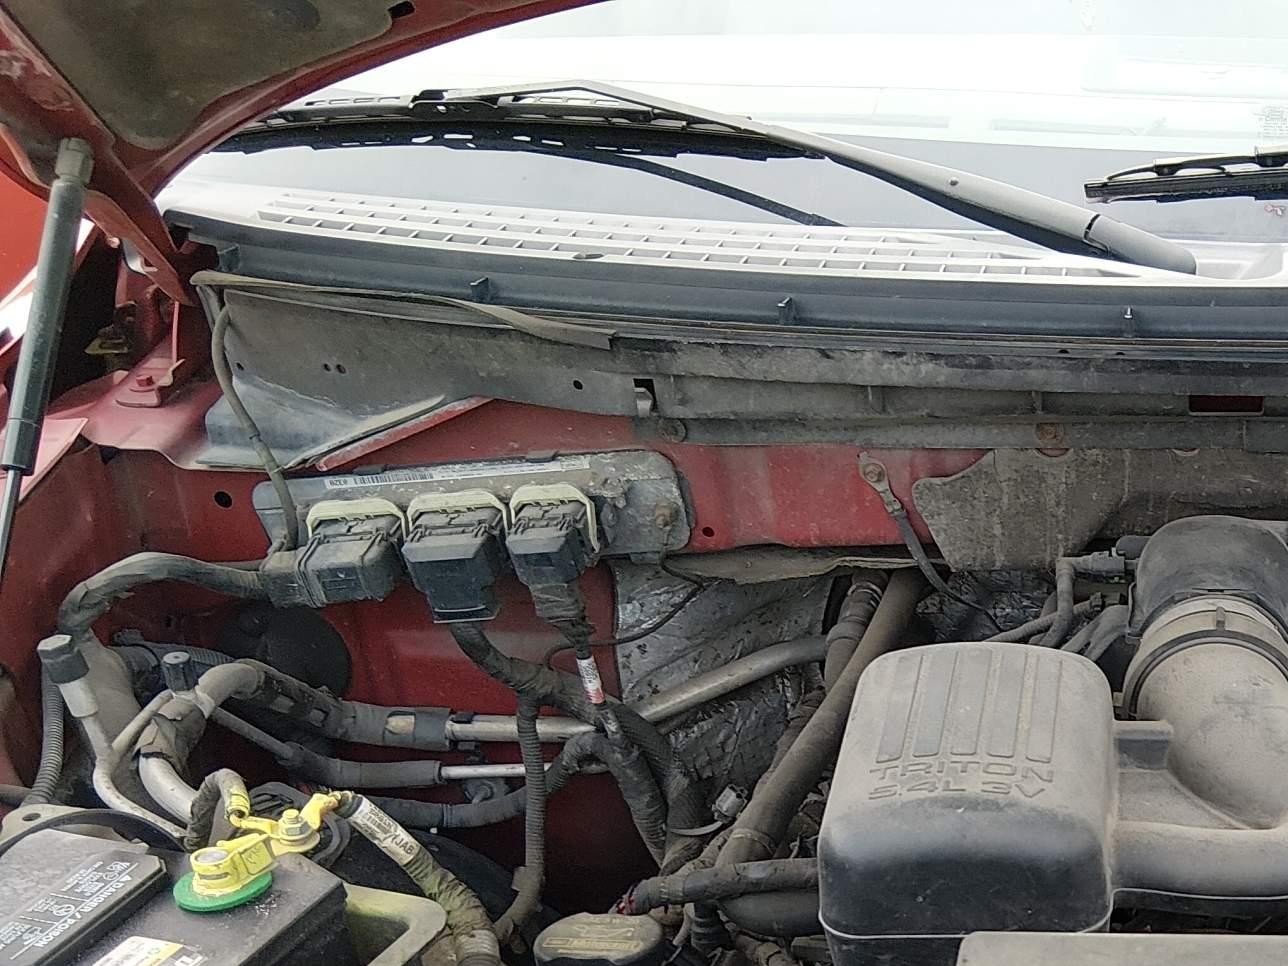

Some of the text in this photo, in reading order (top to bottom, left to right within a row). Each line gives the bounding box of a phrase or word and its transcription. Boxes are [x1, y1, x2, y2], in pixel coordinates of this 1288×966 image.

[869, 760, 1053, 783] TRITON
[868, 780, 1045, 800] 5.4L 3V
[80, 881, 125, 913] DANGER
[33, 918, 77, 947] POISON
